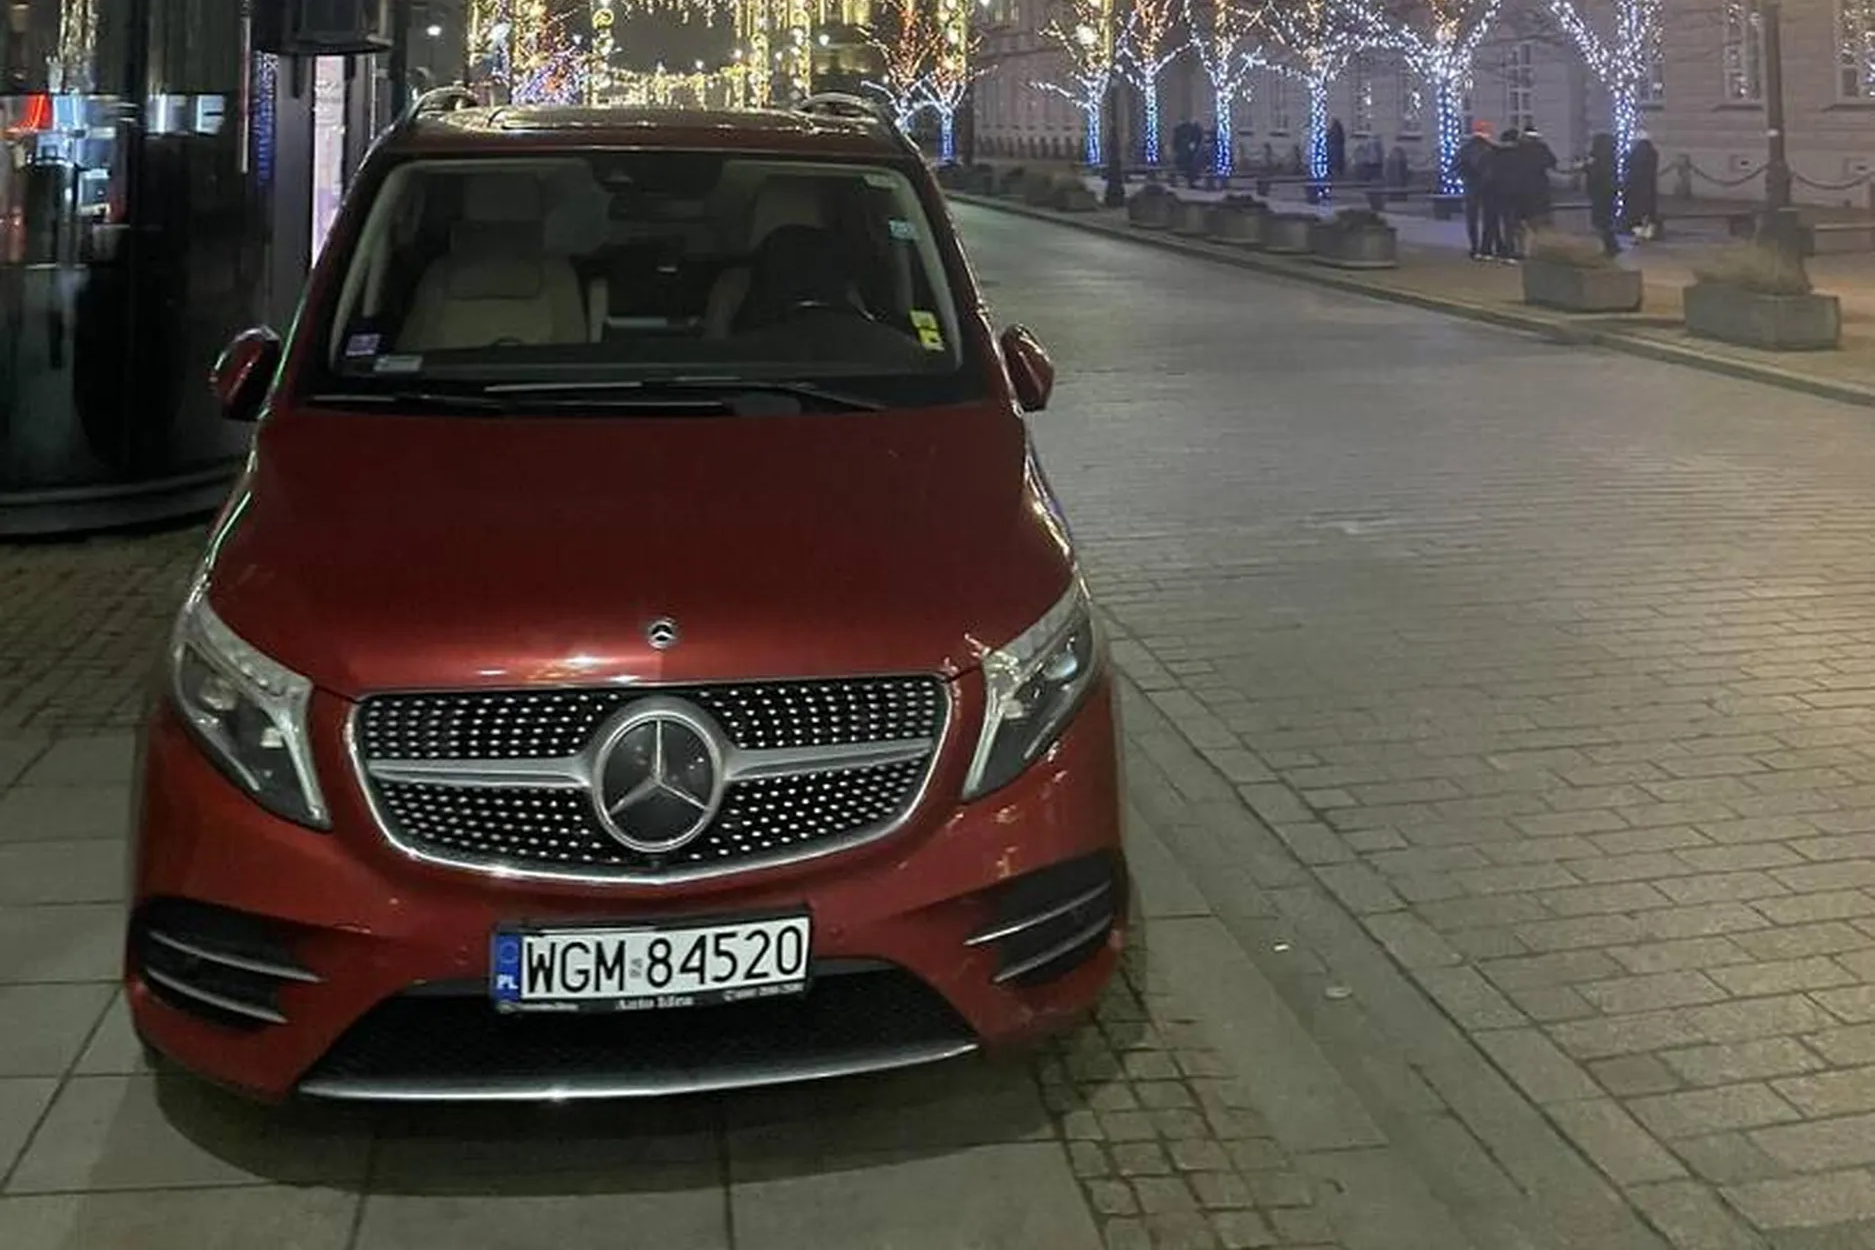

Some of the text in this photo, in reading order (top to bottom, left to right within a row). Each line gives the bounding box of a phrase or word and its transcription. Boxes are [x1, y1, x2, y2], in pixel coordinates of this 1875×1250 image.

[526, 925, 802, 993] WGM 84520
[496, 975, 518, 990] PL
